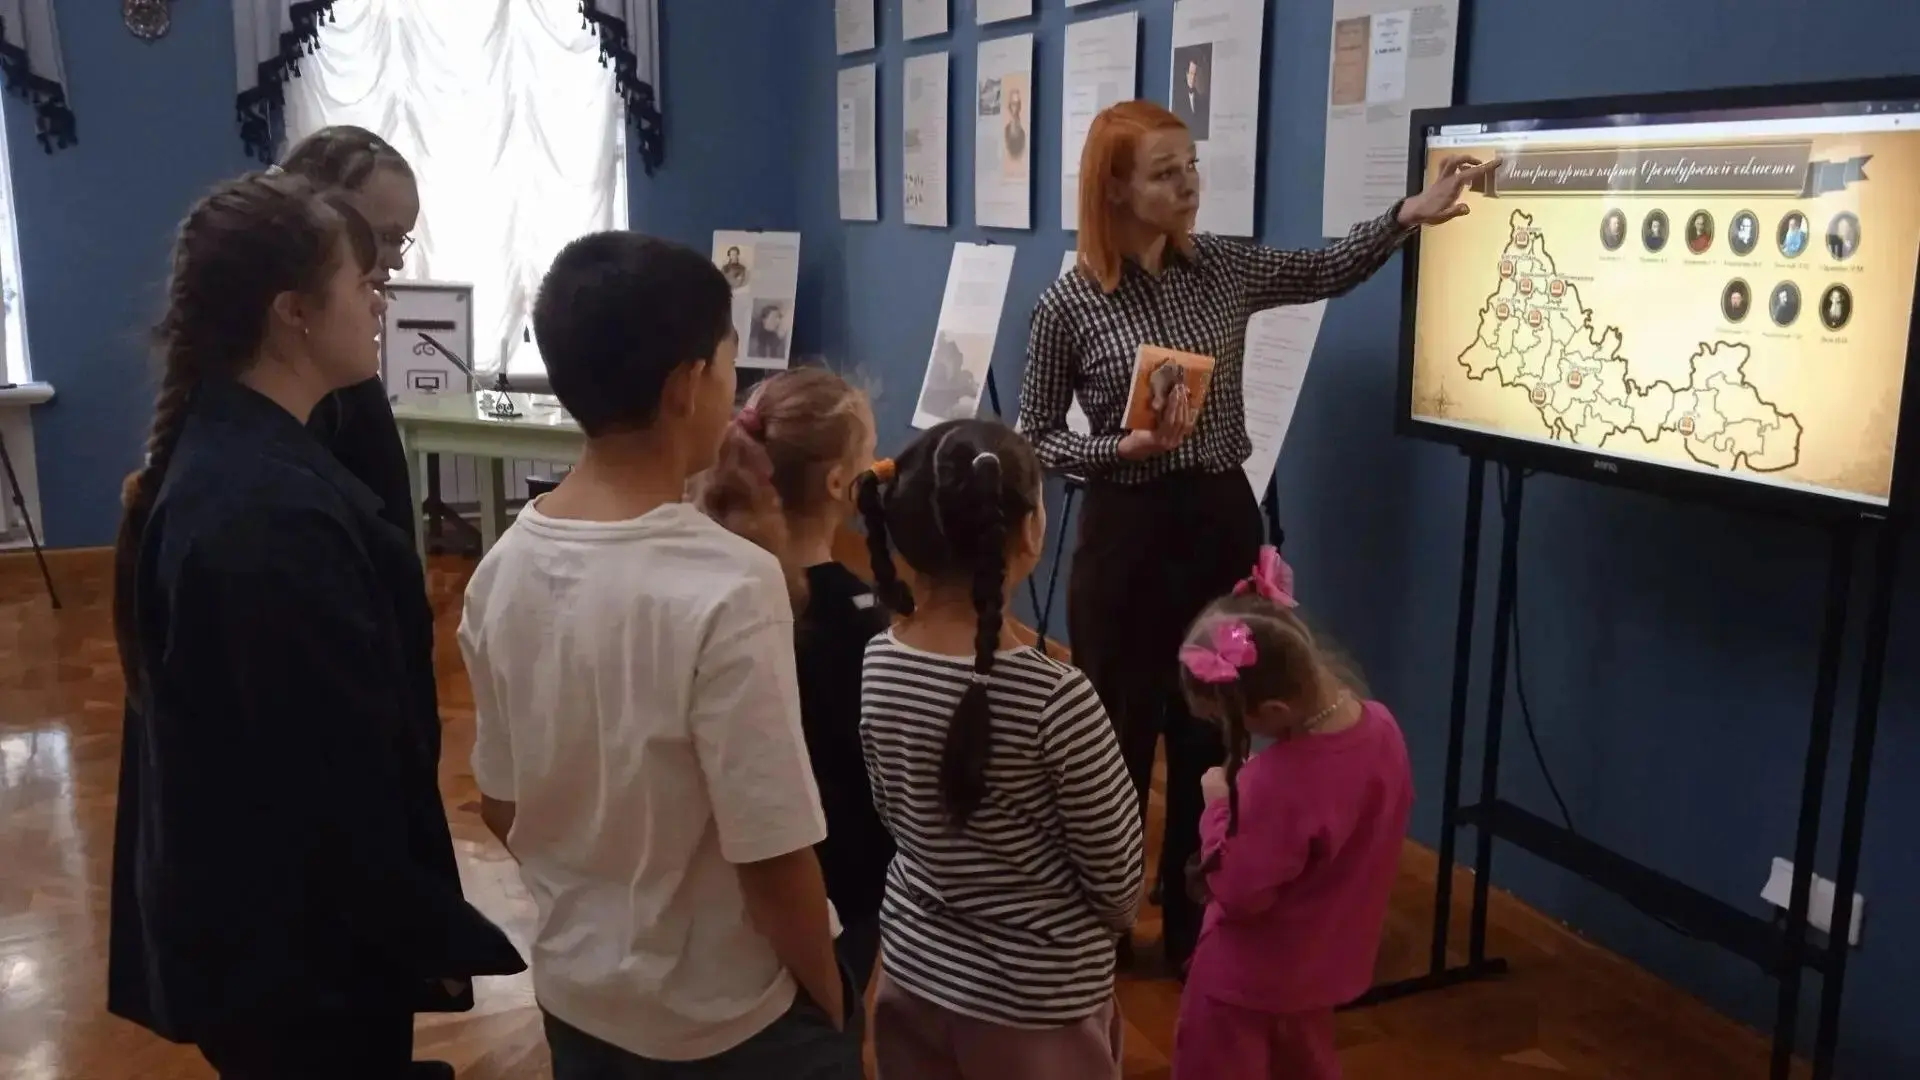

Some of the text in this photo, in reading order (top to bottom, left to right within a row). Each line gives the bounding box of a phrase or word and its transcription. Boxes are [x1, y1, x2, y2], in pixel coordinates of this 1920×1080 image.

[1596, 162, 1637, 184] карта
[1640, 157, 1732, 184] Оренбургской
[1733, 155, 1795, 176] области
